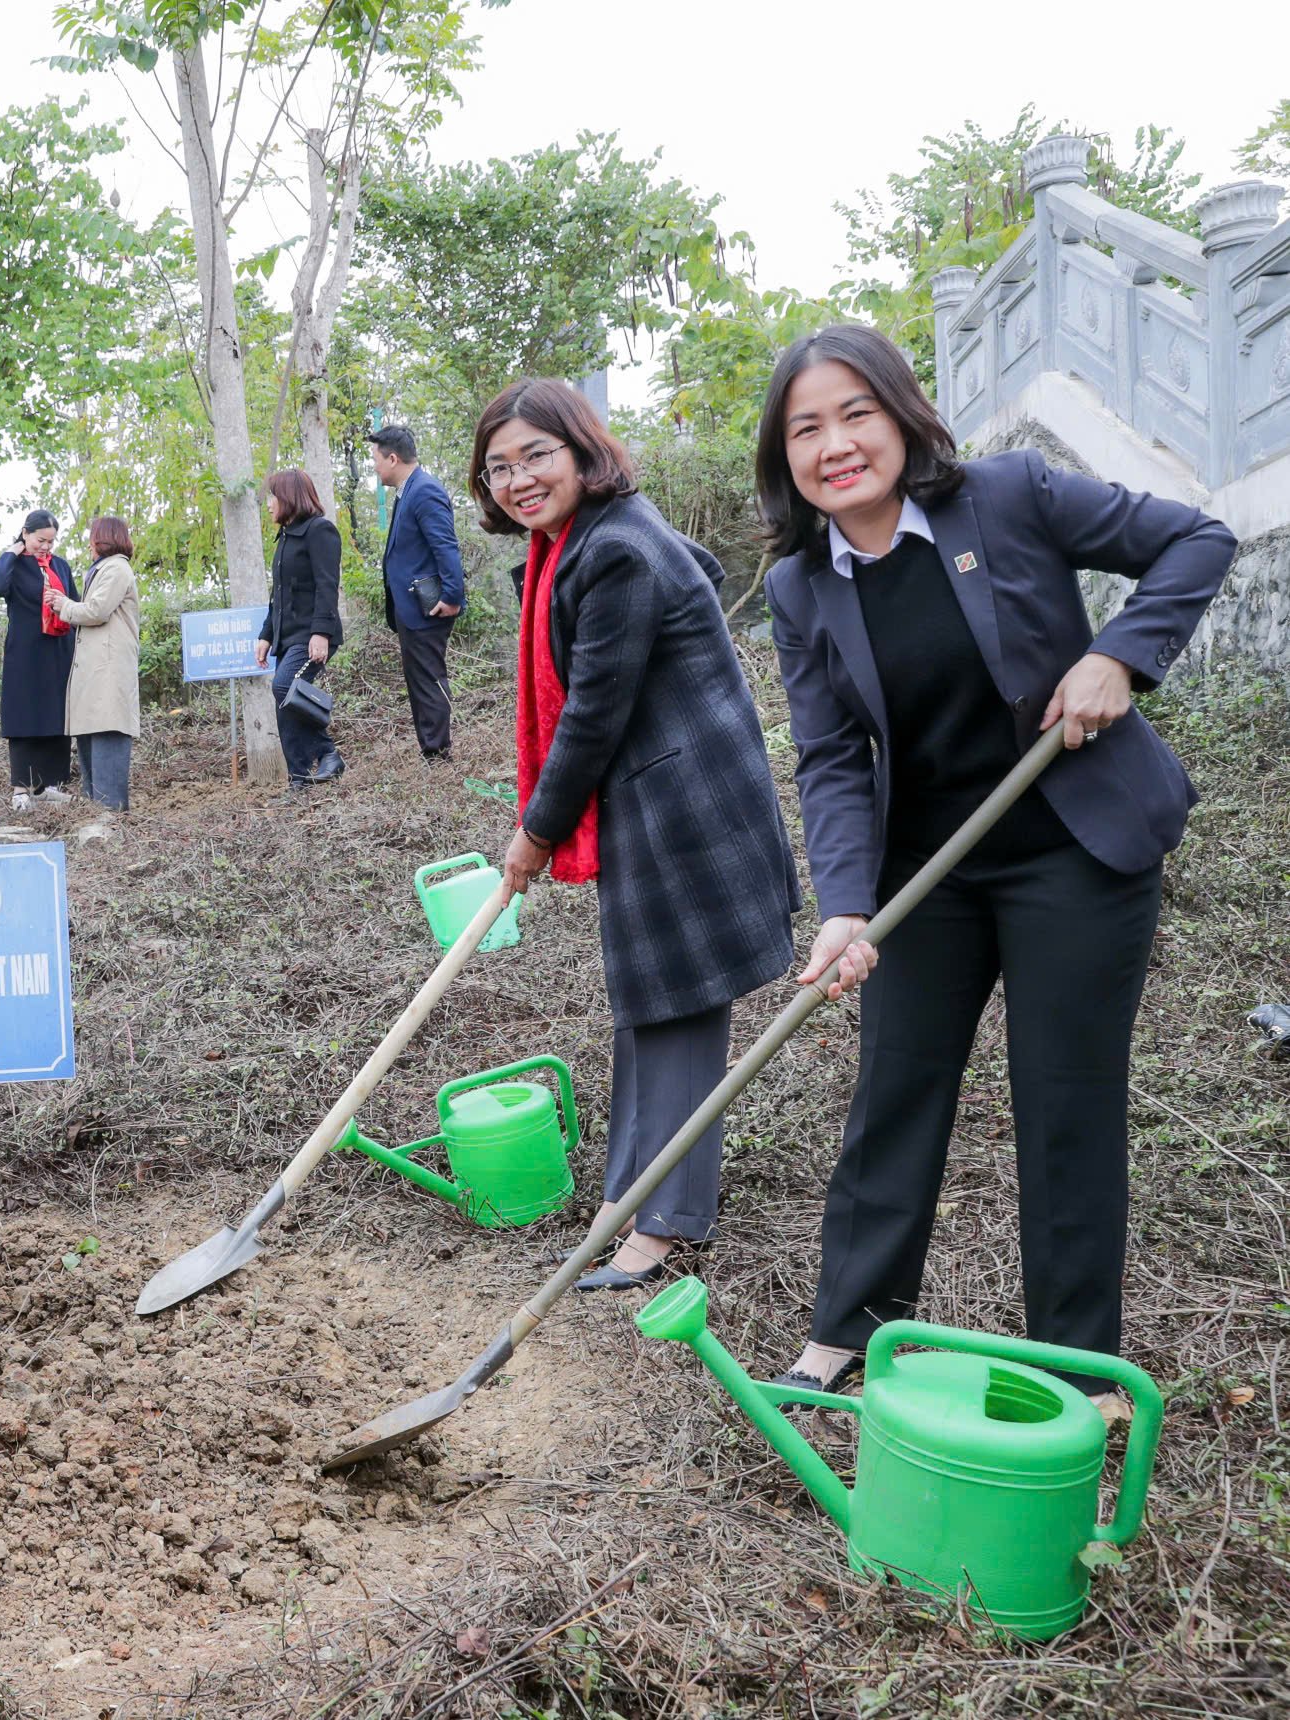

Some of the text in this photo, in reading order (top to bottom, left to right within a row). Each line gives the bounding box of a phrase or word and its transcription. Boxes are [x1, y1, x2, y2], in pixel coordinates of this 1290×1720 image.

[208, 639, 223, 656] TÁC
[236, 638, 251, 655] VIỆT
[10, 953, 50, 996] NAM
